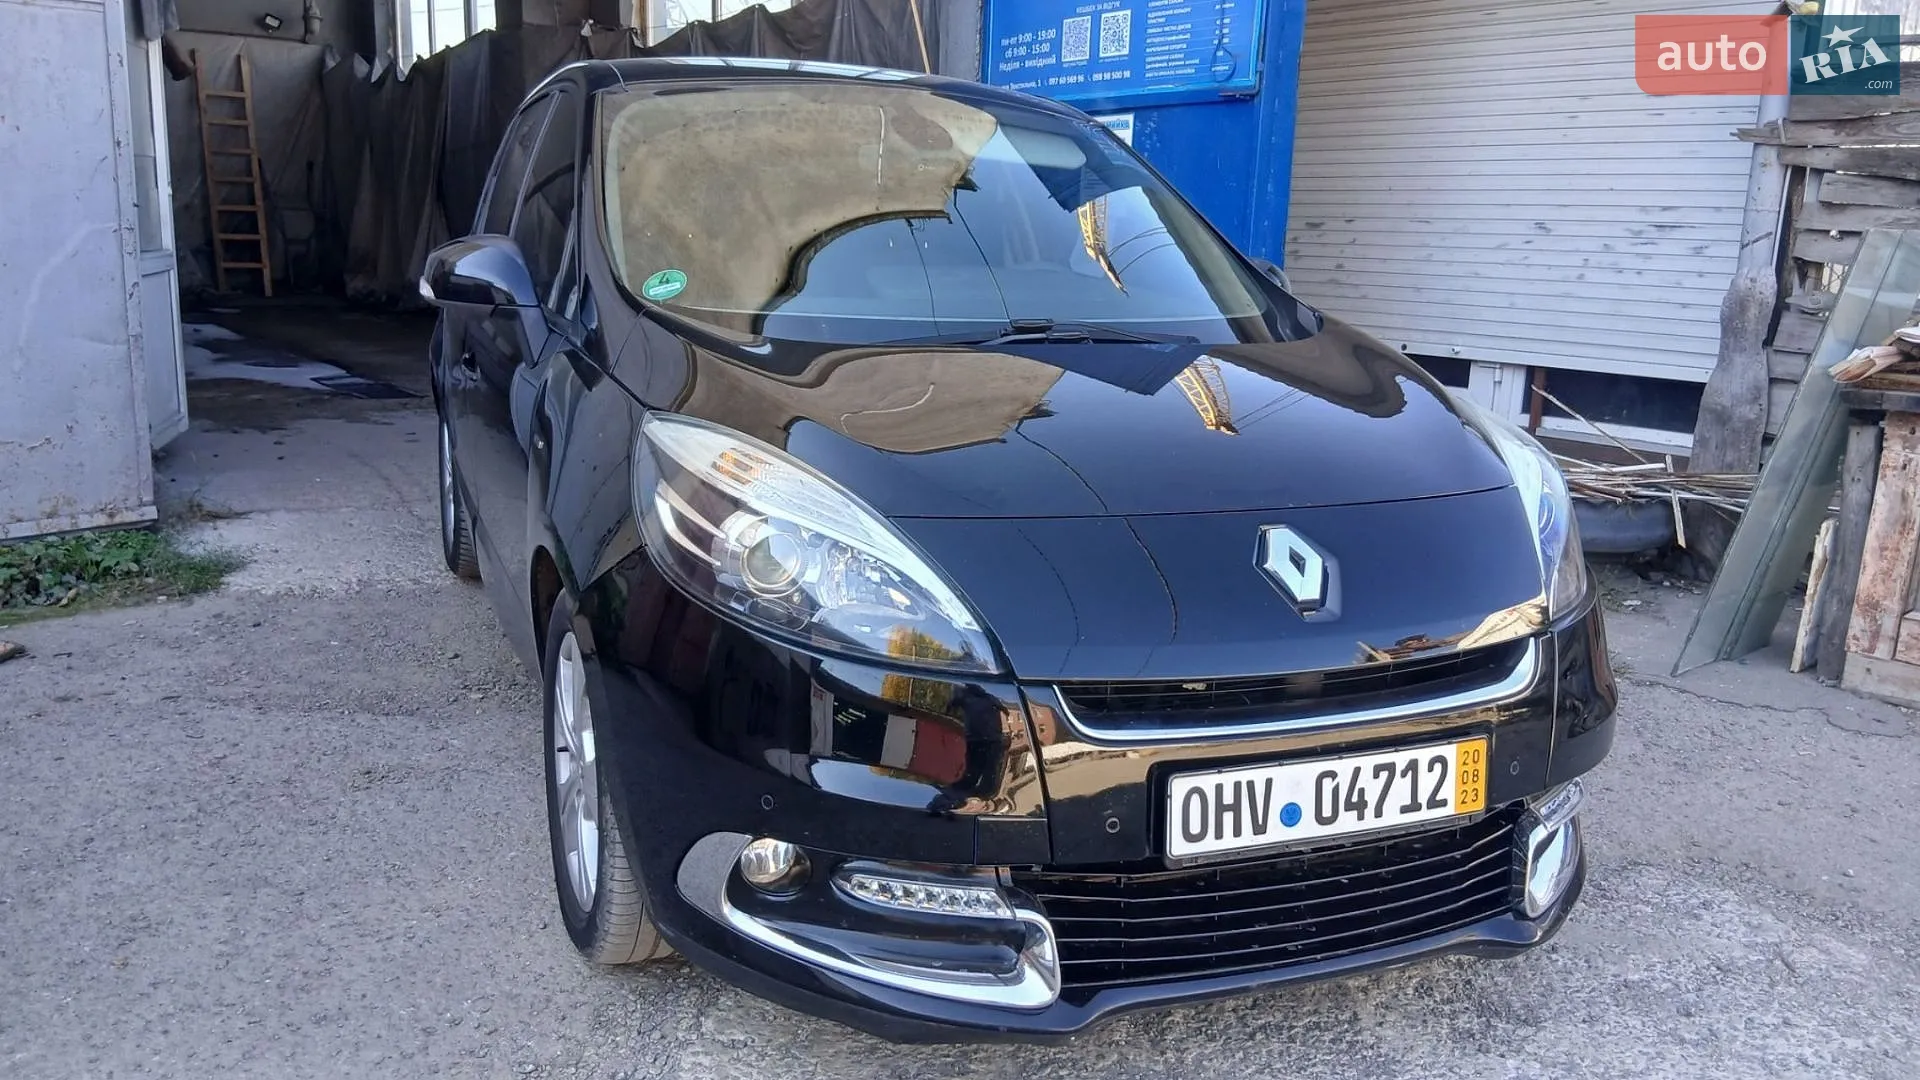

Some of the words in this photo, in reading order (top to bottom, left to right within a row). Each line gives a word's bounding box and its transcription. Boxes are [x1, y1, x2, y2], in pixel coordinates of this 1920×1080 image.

[1032, 43, 1051, 55] 15:00
[1462, 749, 1480, 766] 20
[1461, 768, 1479, 785] 08
[1181, 777, 1273, 844] OHV
[1315, 754, 1448, 827] 04712
[1461, 788, 1479, 804] 23
